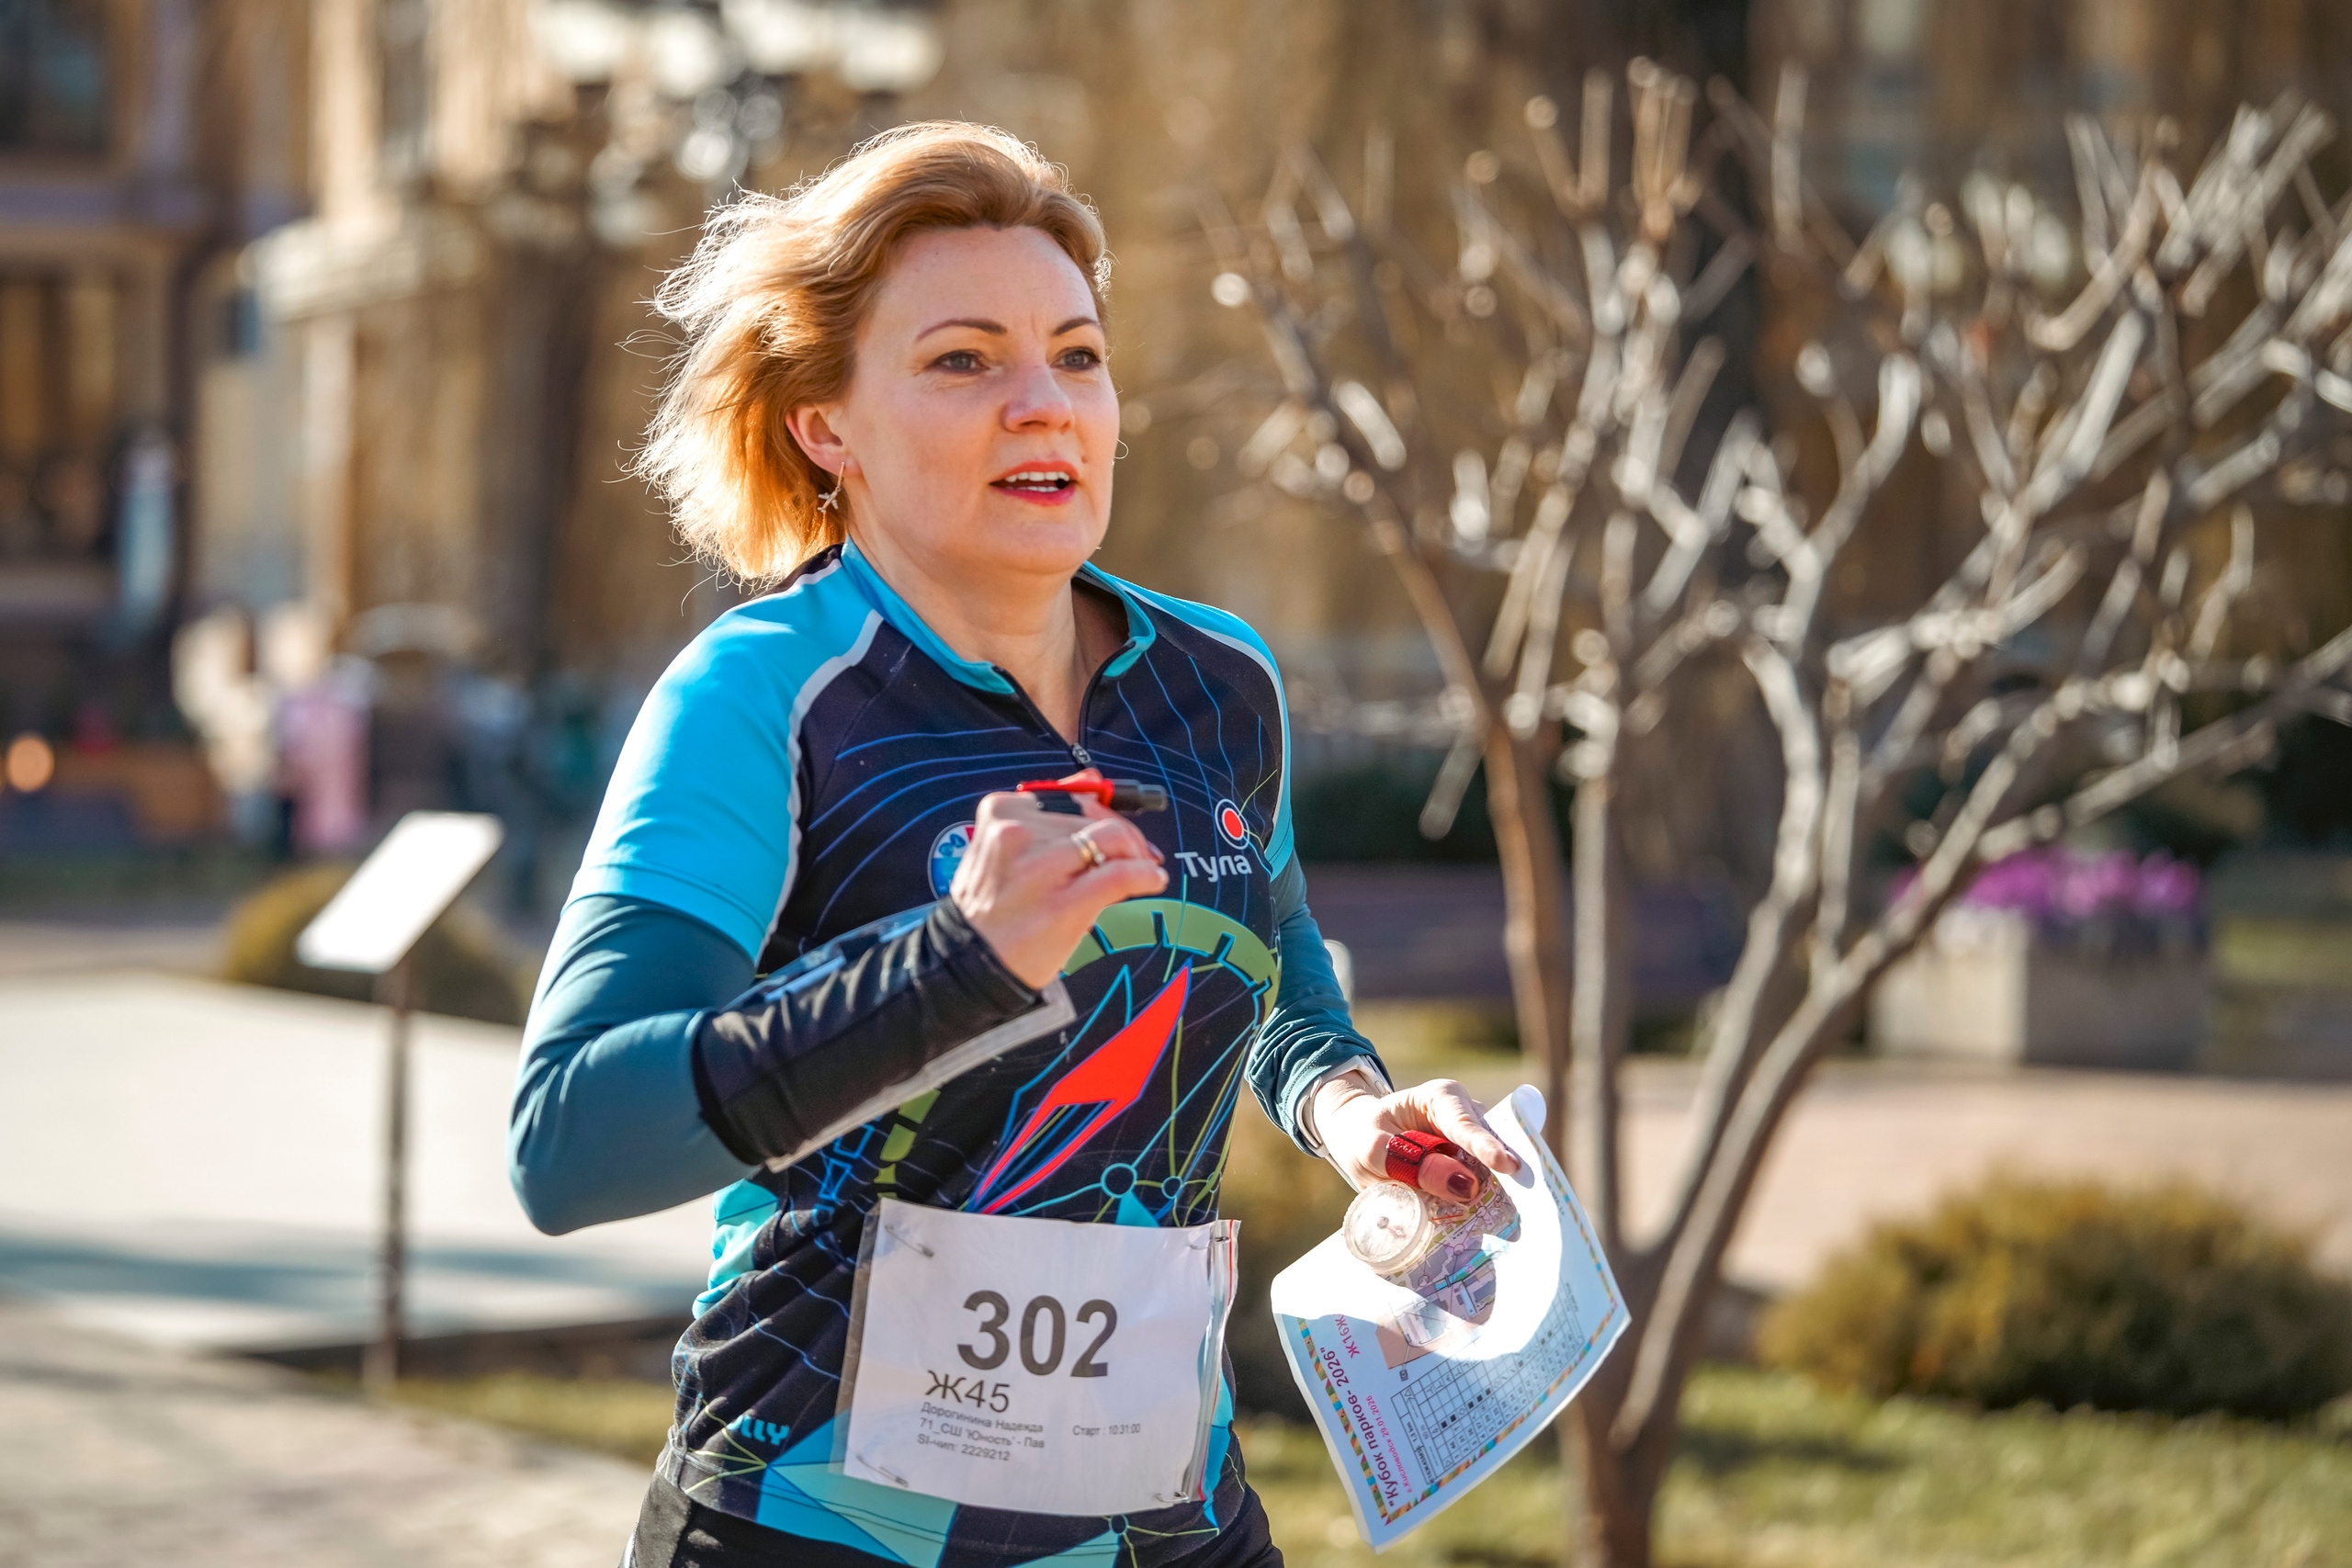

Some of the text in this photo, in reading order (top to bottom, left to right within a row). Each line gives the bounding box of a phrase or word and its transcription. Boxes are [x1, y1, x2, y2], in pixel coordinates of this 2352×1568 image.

[1174, 852, 1252, 882] Тула
[956, 1290, 1118, 1378] 302
[924, 1370, 1011, 1413] Ж45
[995, 1418, 1044, 1434] Надежда
[1072, 1425, 1100, 1437] Старт
[1320, 1347, 1399, 1506] "Кубок парков- 2026"
[1365, 1395, 1389, 1438] 29.01.2026
[961, 1443, 1011, 1461] 2229212
